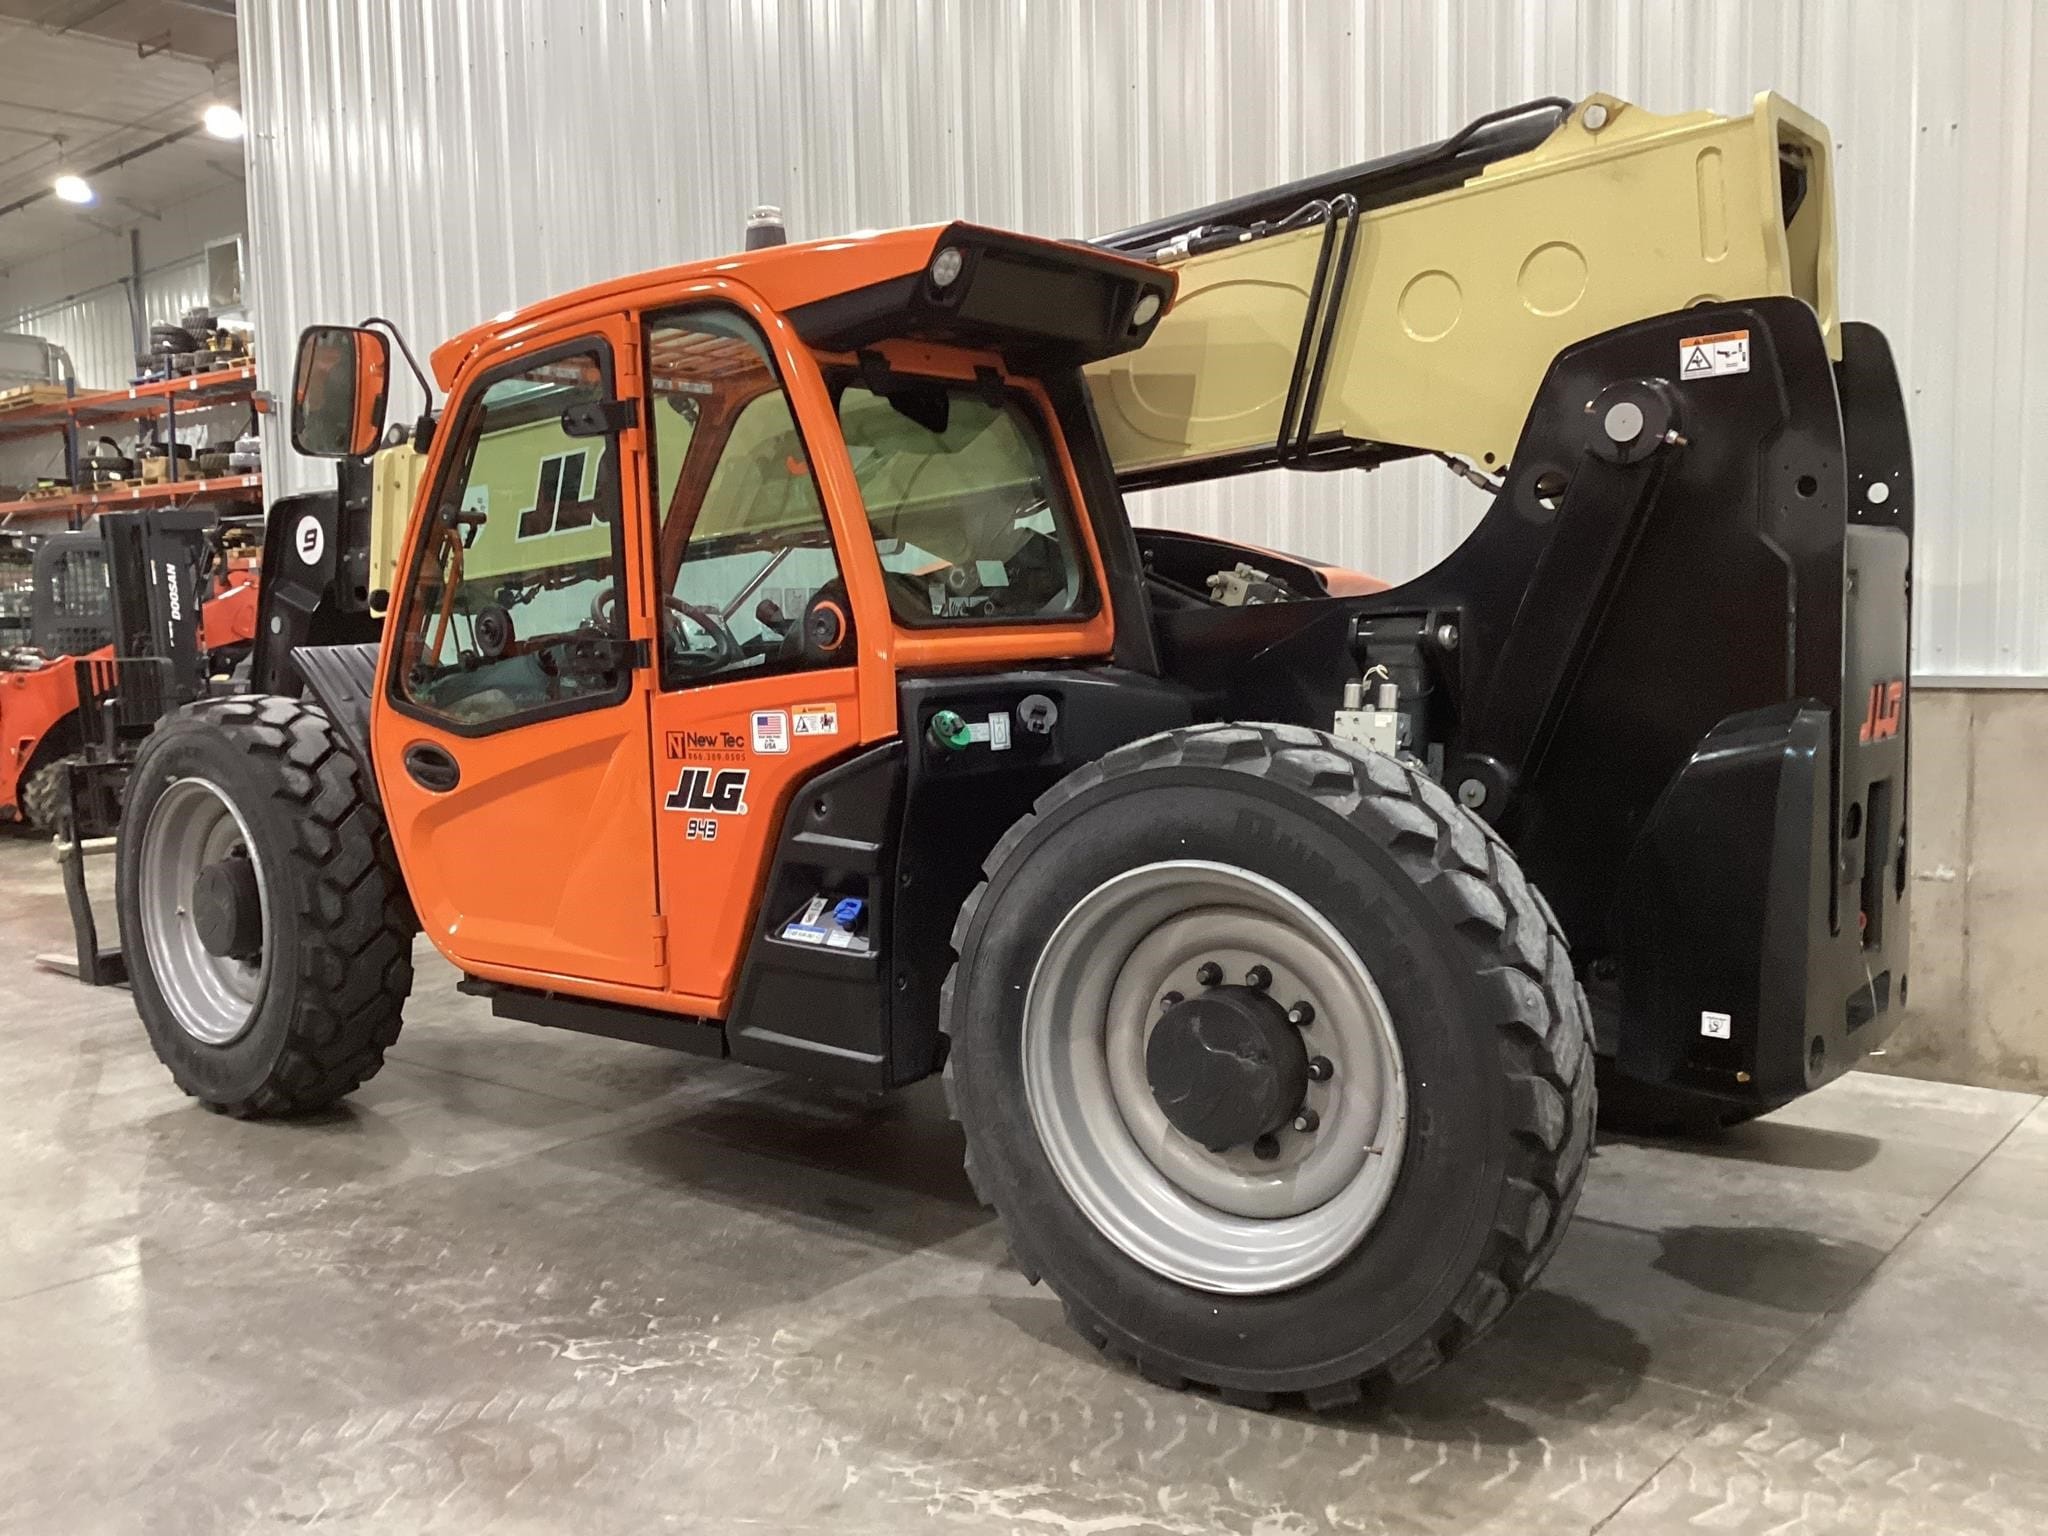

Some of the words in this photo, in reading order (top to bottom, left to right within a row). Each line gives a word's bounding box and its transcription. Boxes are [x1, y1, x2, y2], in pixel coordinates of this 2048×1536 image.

[302, 528, 318, 553] 9
[165, 562, 182, 621] DOOSAN
[1859, 680, 1904, 746] JLG
[687, 731, 718, 748] New
[720, 731, 745, 748] Tec
[664, 767, 749, 814] JLG
[686, 819, 718, 840] 943
